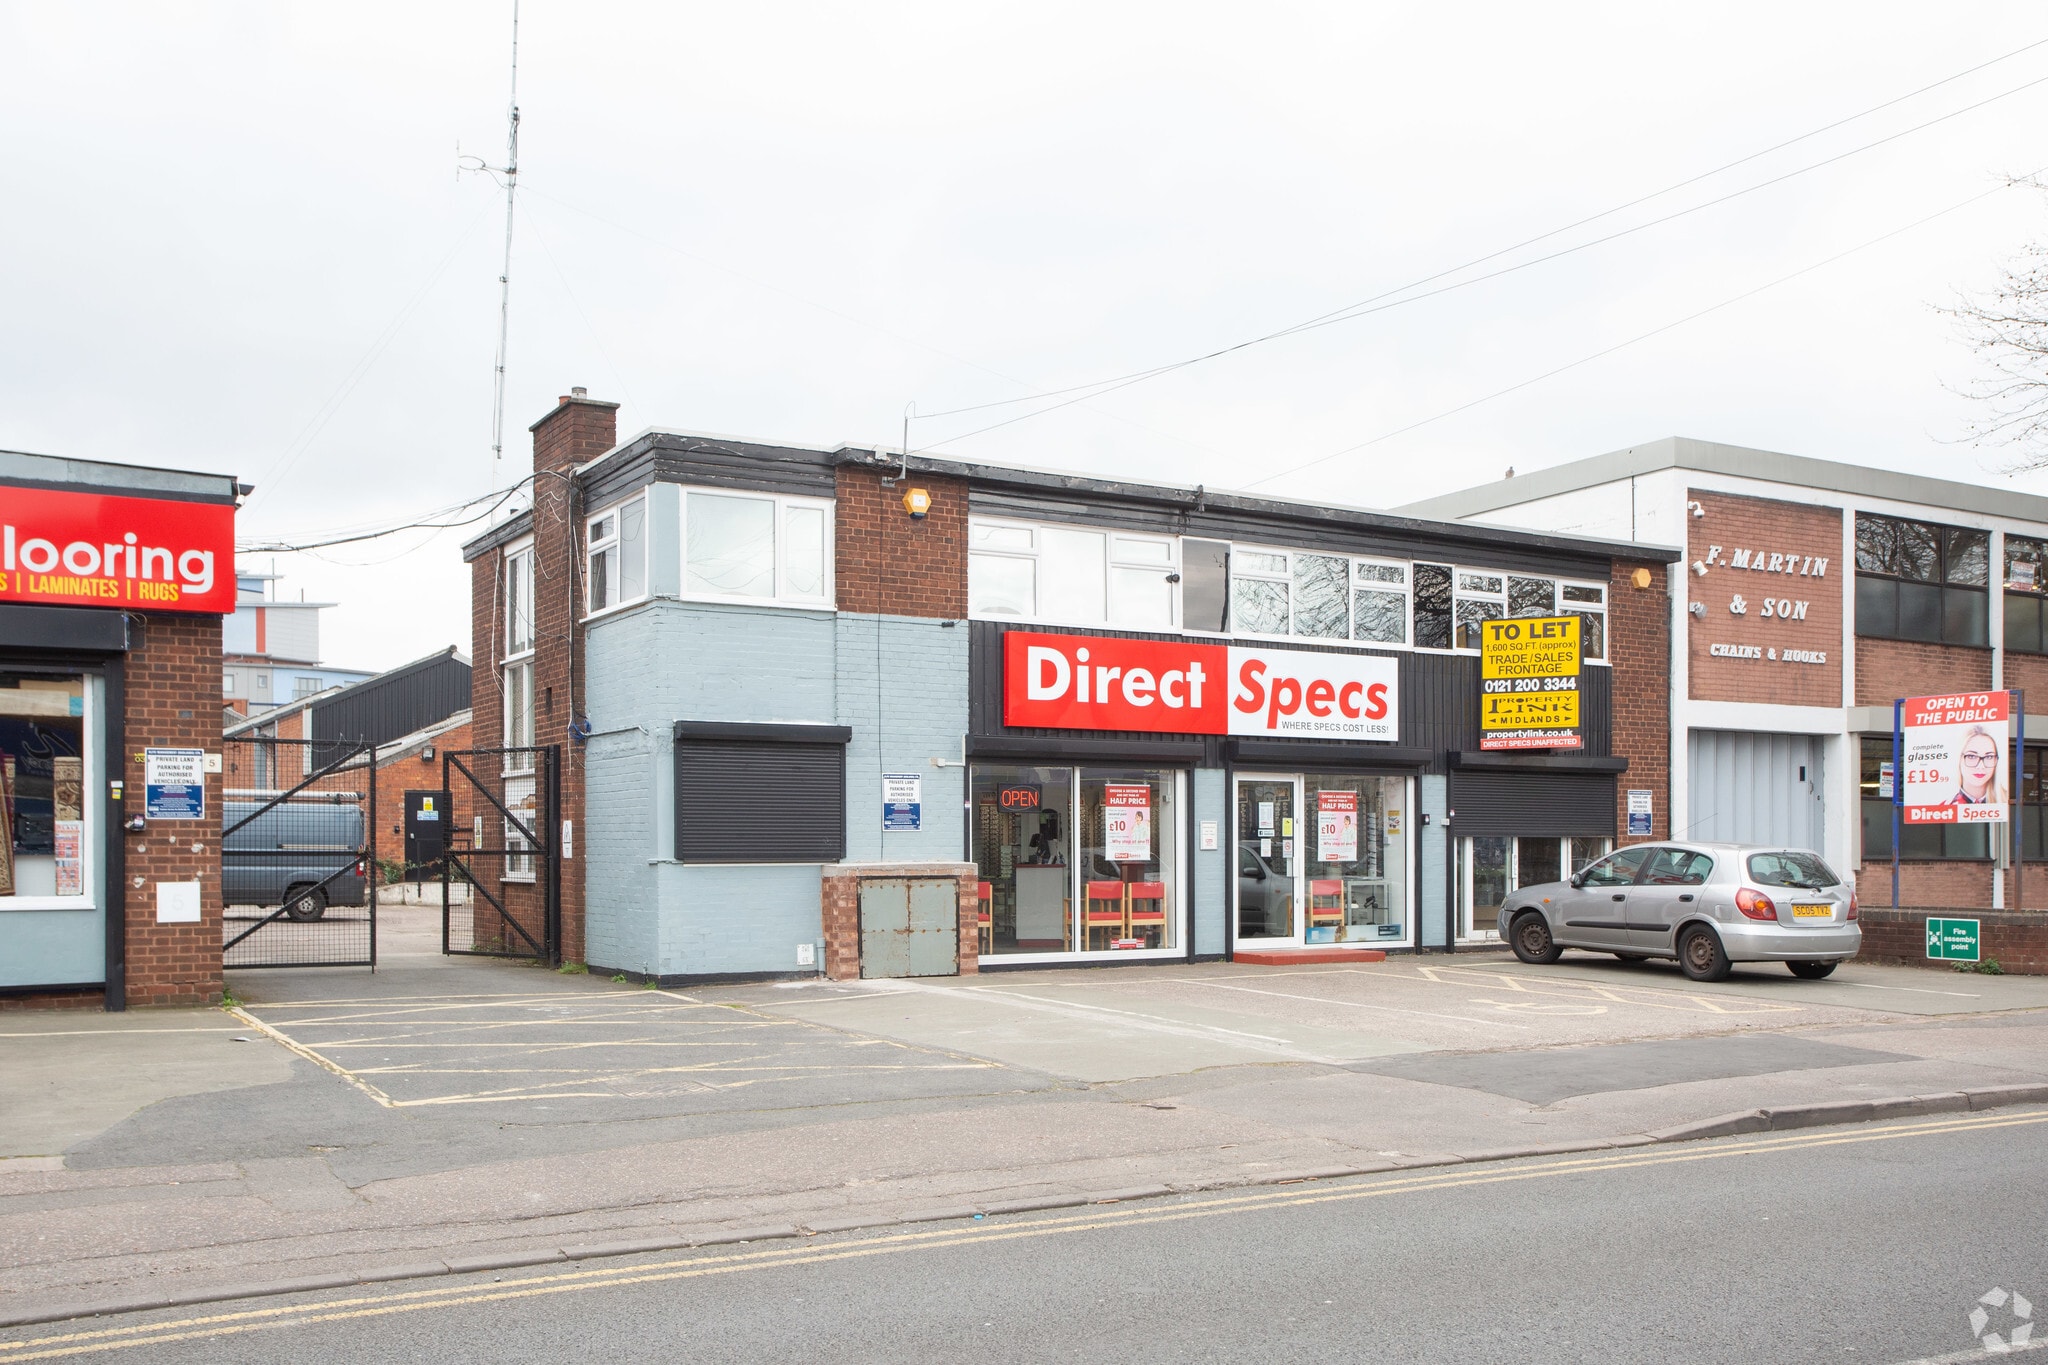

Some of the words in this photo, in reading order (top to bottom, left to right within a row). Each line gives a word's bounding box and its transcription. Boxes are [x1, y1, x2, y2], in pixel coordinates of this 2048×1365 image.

[29, 575, 119, 599] LAMINATES
[139, 581, 179, 602] RUGS
[1729, 594, 1747, 615] &
[1760, 597, 1810, 620] SON
[1491, 624, 1521, 641] TO
[1530, 621, 1571, 639] LET
[1486, 643, 1508, 652] 1,600
[1539, 640, 1576, 650] (approx)
[1710, 643, 1762, 659] CHAINS
[1767, 647, 1777, 661] &
[1782, 649, 1827, 664] HOOKS
[1498, 663, 1562, 675] FRONTAGE
[1027, 645, 1207, 709] Direct
[1233, 658, 1388, 730] Specs
[1485, 679, 1511, 693] 0121
[1515, 678, 1540, 692] 200
[1544, 677, 1576, 691] 3344
[1499, 696, 1573, 704] PROPERTY
[1926, 696, 1964, 710] OPEN
[1969, 695, 1989, 707] TO
[1500, 715, 1560, 725] MIDLANDS
[1916, 713, 1942, 725] THE
[1946, 708, 1998, 723] PUBLIC
[1282, 721, 1312, 730] WHERE
[1314, 722, 1341, 732] SPECS
[1343, 723, 1364, 733] COST
[1366, 724, 1389, 734] LESS!
[1486, 729, 1573, 739] propertylink.co.uk
[1483, 739, 1508, 748] DIRECT
[1508, 738, 1531, 748] SPECS
[1532, 737, 1577, 747] UNAFFECTED
[1912, 743, 1944, 752] complete
[1908, 751, 1949, 763] glasses
[1001, 790, 1038, 807] OPEN
[1110, 797, 1127, 805] HALF
[1128, 797, 1146, 805] PRICE
[1911, 807, 1954, 820] Direct
[1963, 806, 2000, 821] Specs
[1109, 820, 1126, 831] £10
[1321, 824, 1336, 834] £10
[1943, 936, 1976, 944] assembly
